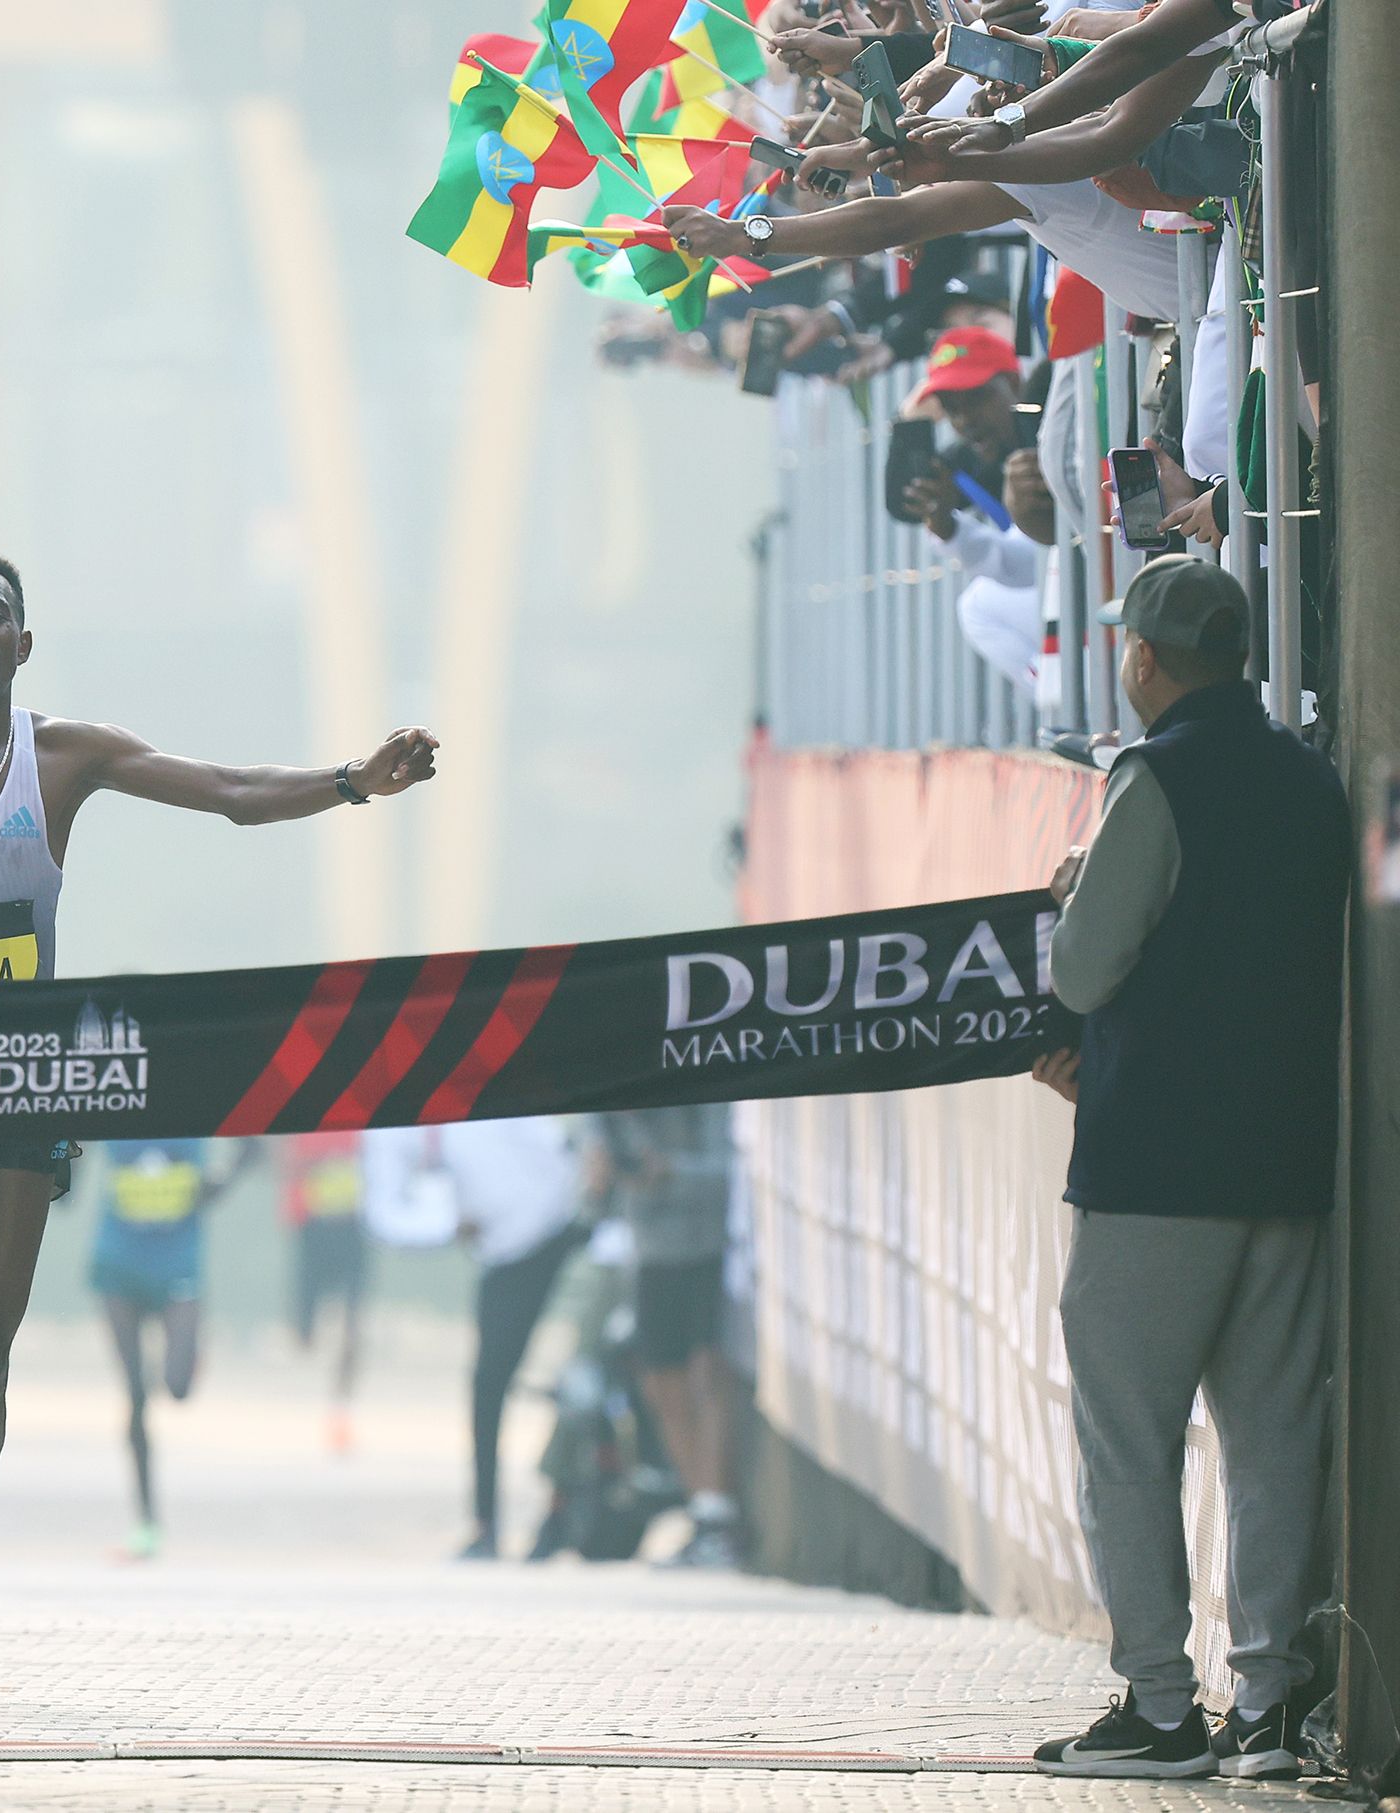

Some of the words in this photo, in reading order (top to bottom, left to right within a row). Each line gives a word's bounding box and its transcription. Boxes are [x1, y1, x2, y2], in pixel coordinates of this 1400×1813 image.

[0, 826, 41, 839] adidas
[666, 911, 1057, 1030] DUBAI
[662, 1014, 940, 1068] MARATHON
